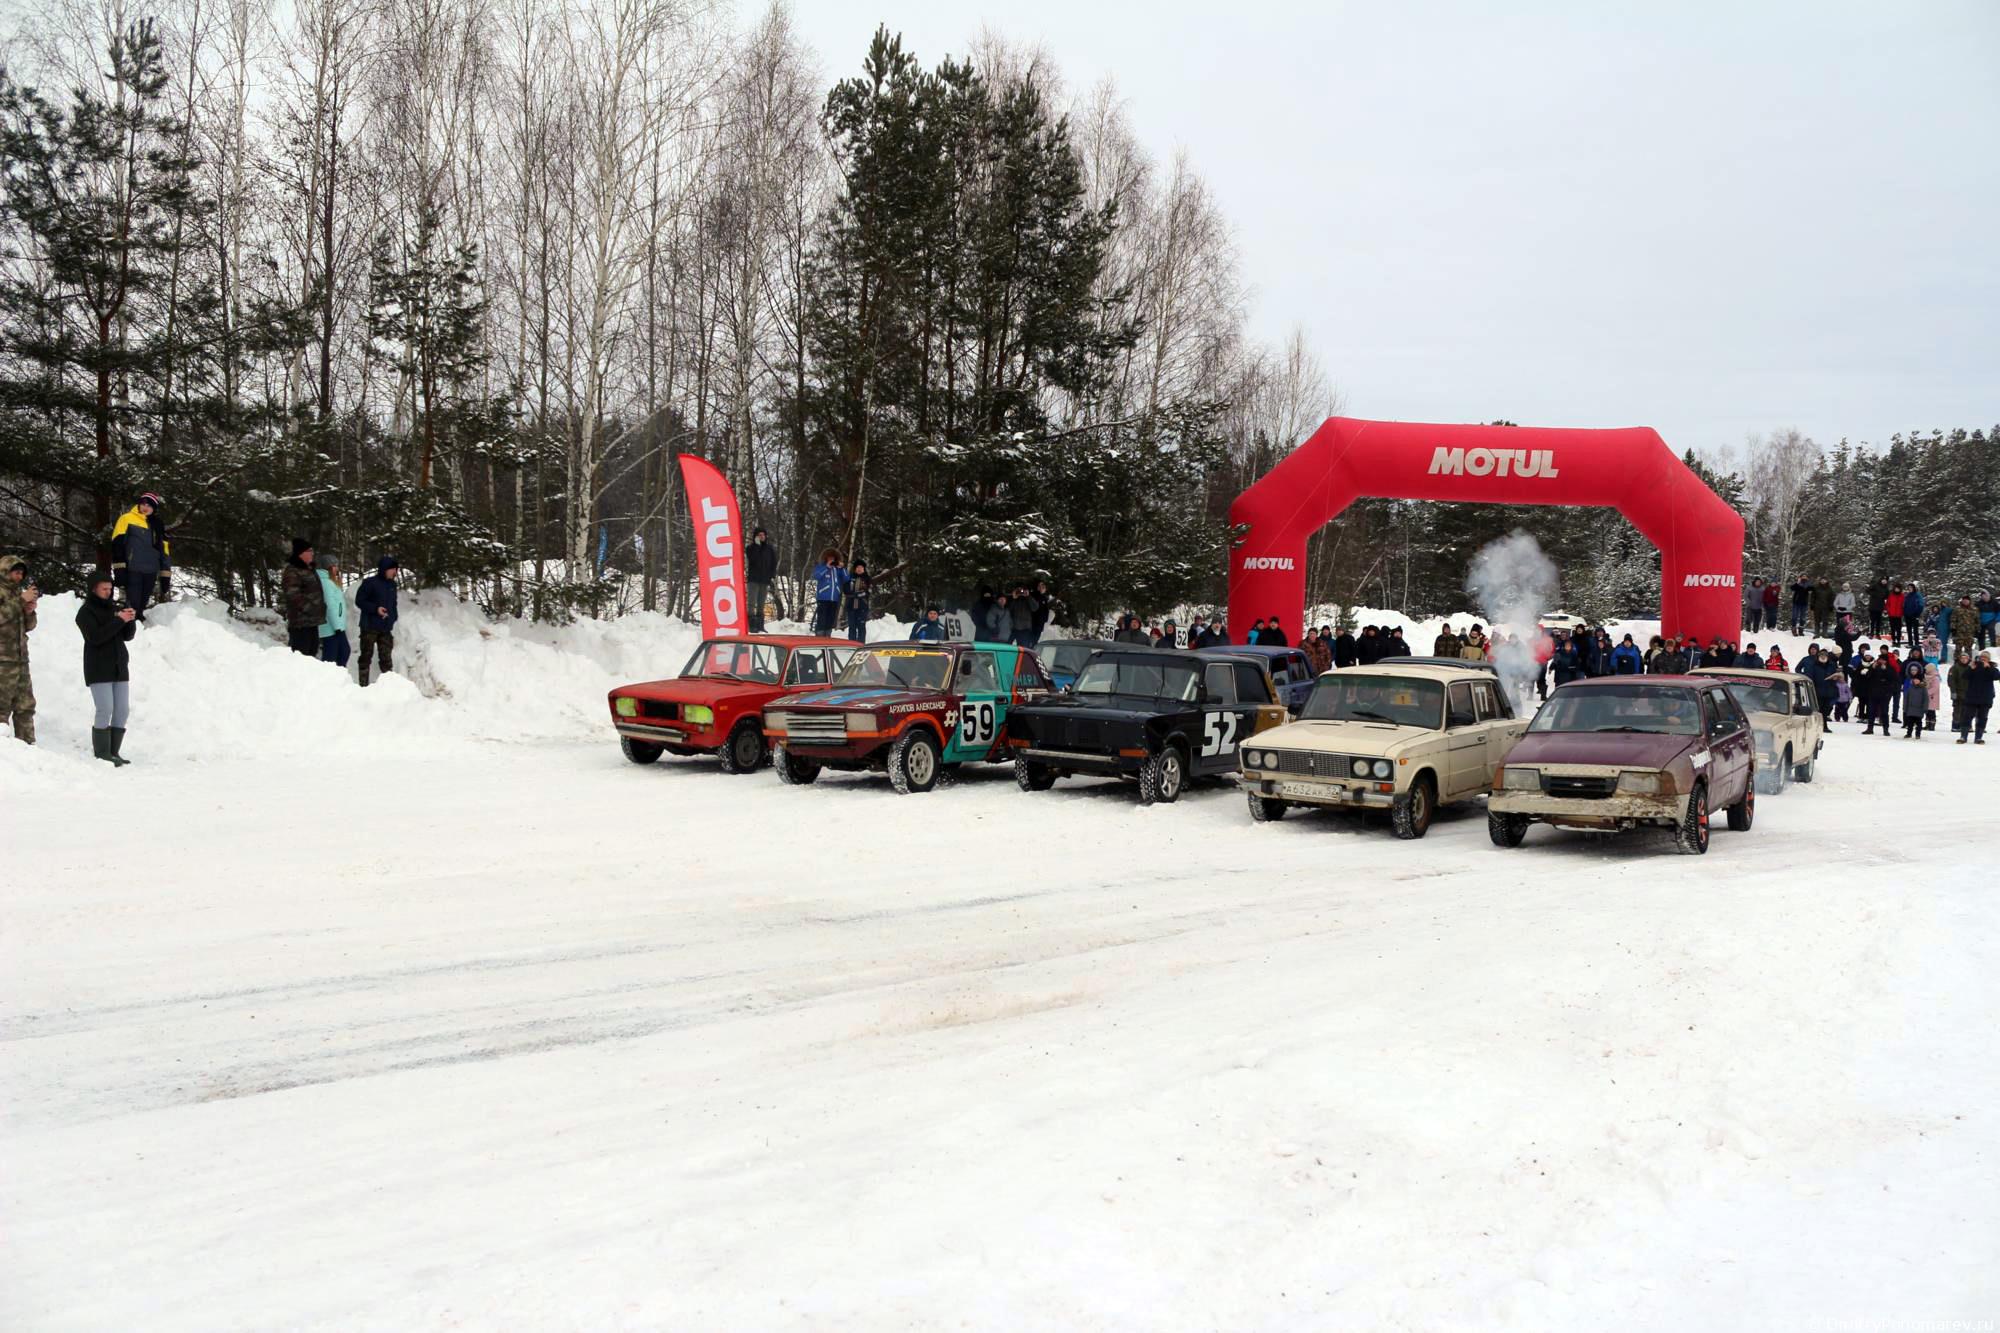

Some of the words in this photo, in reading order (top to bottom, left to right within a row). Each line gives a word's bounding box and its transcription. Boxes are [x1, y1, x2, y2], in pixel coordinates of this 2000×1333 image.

[1428, 446, 1559, 478] MOTUL
[1243, 557, 1295, 571] MOTUL
[1683, 574, 1736, 588] MOTUL
[948, 618, 962, 637] 59
[1104, 626, 1114, 640] 56
[1176, 630, 1188, 646] 52
[962, 703, 994, 742] 59
[1202, 711, 1236, 757] 52
